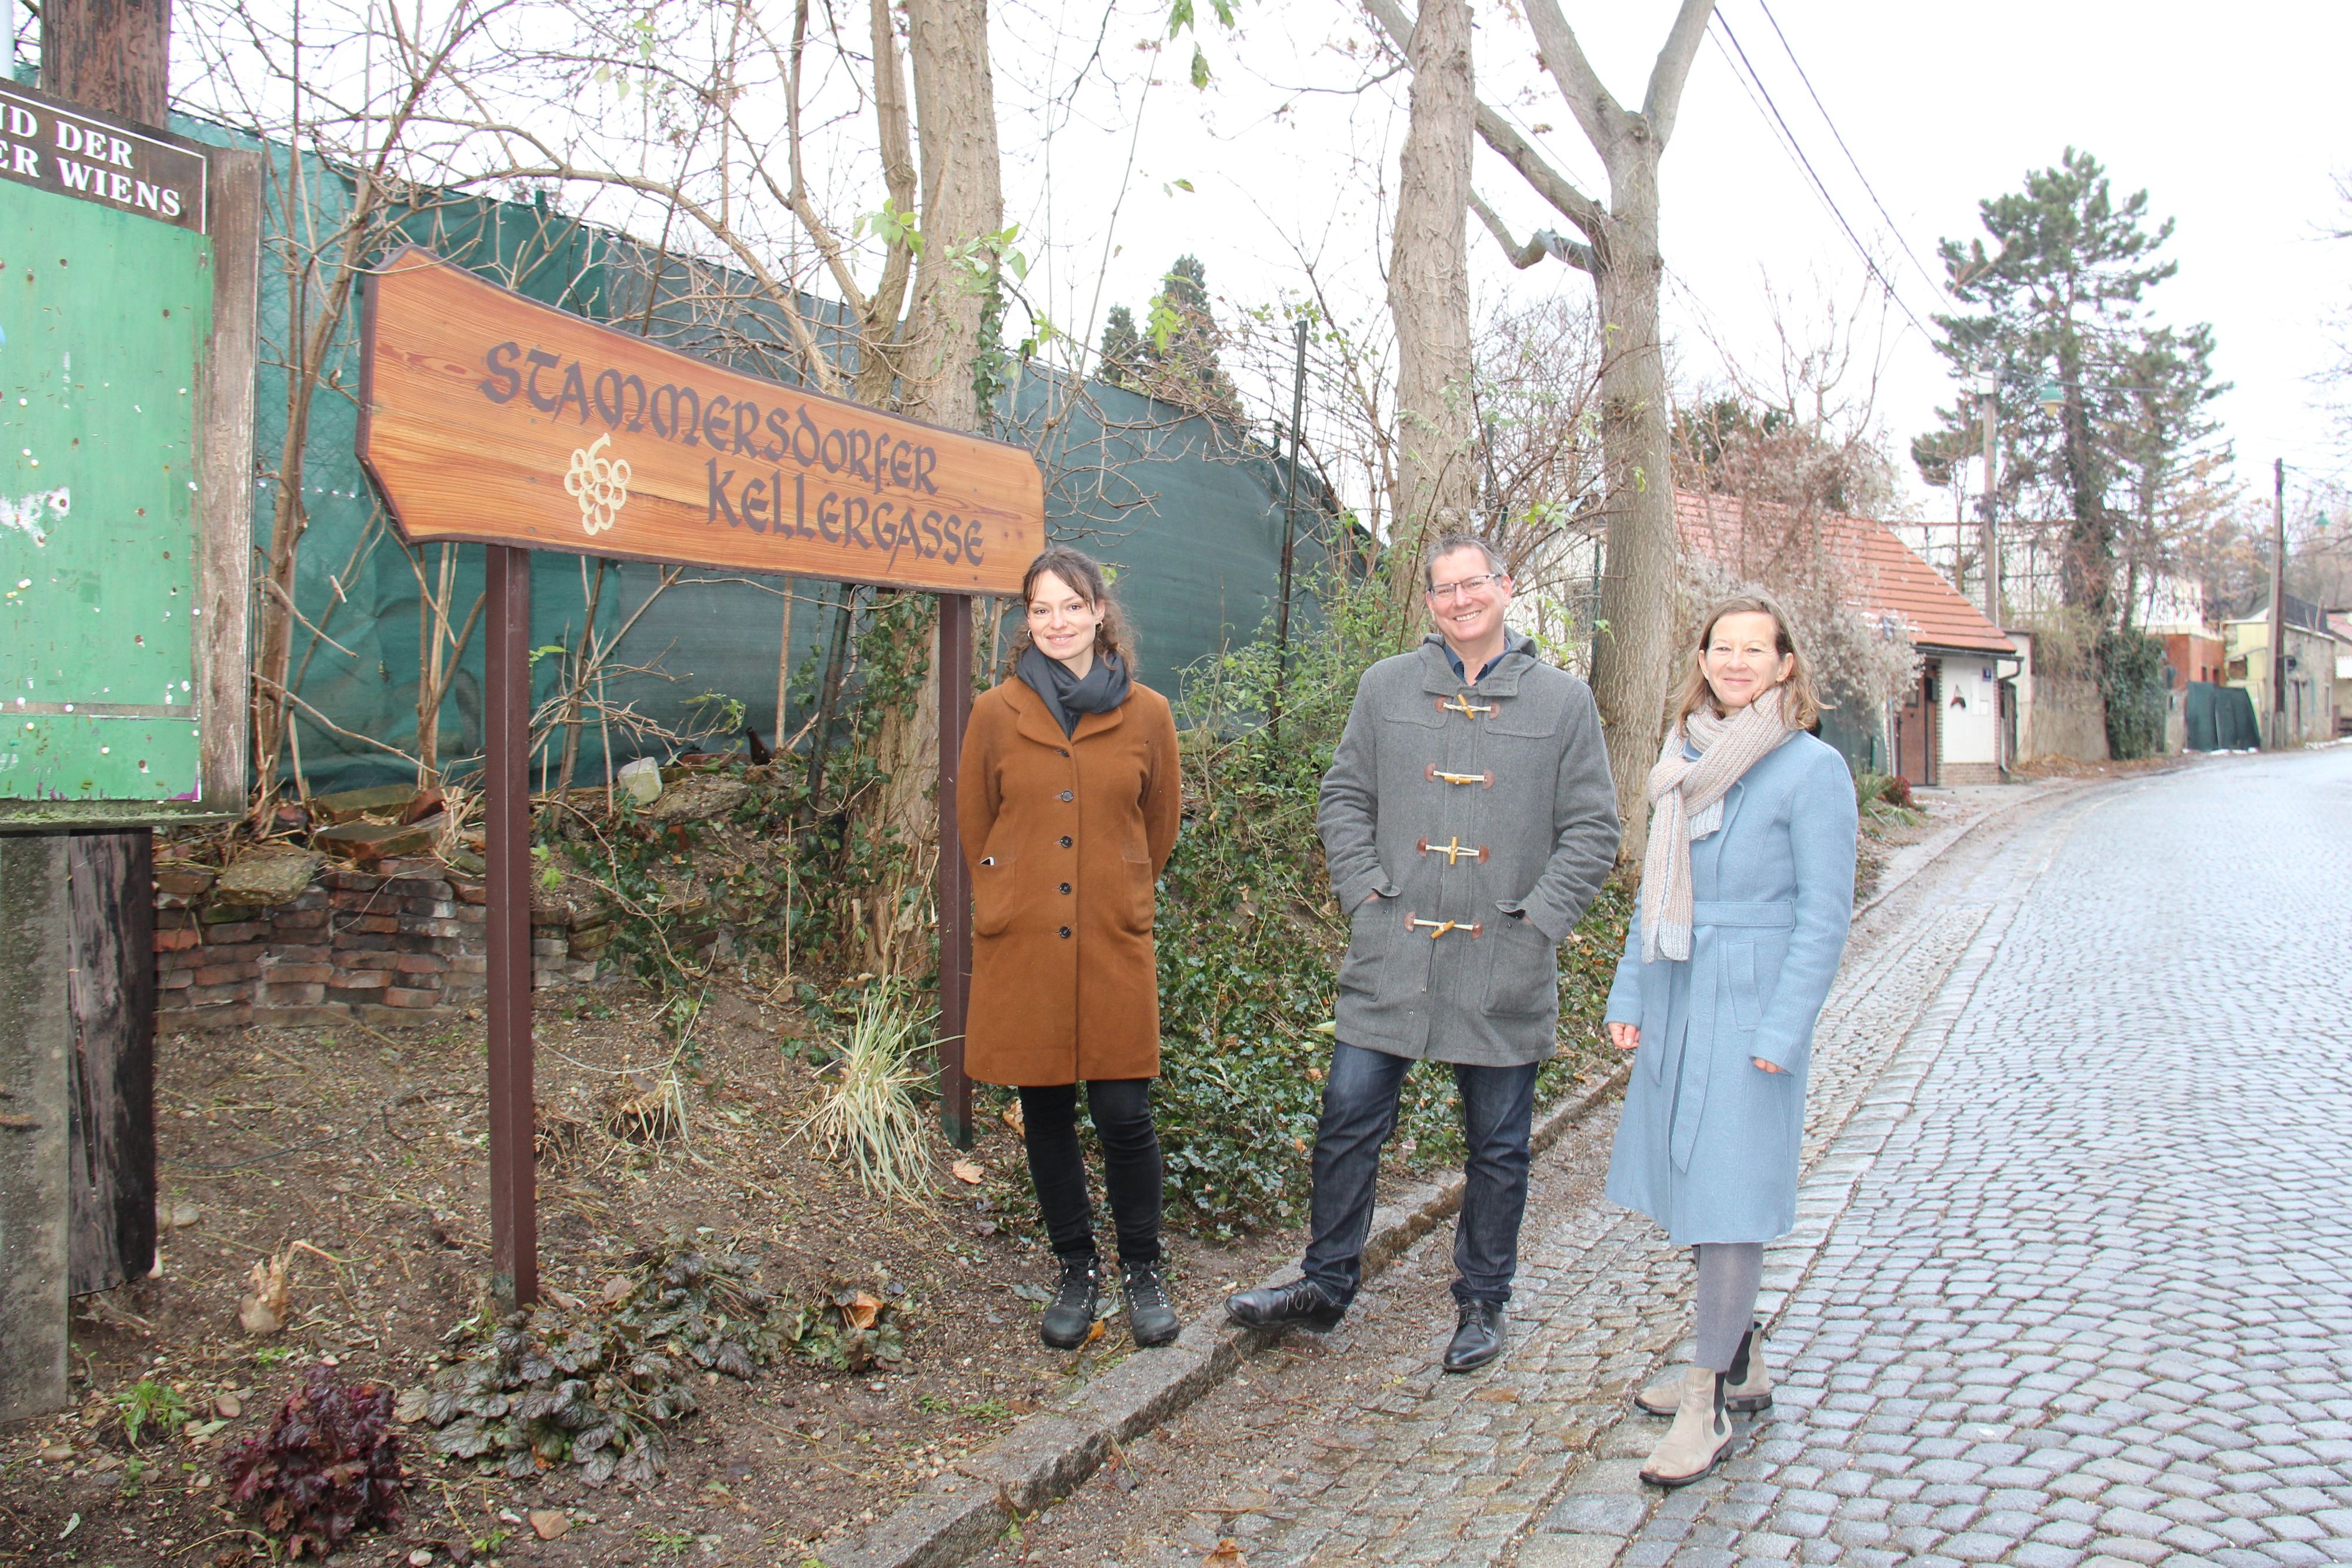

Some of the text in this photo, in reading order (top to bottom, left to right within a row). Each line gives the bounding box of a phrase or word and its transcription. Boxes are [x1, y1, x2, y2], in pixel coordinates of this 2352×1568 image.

[0, 102, 133, 169] D DER
[56, 157, 181, 216] WIENS
[476, 342, 939, 496] STAMMERSDORFER
[705, 457, 985, 573] KELLERGASSE
